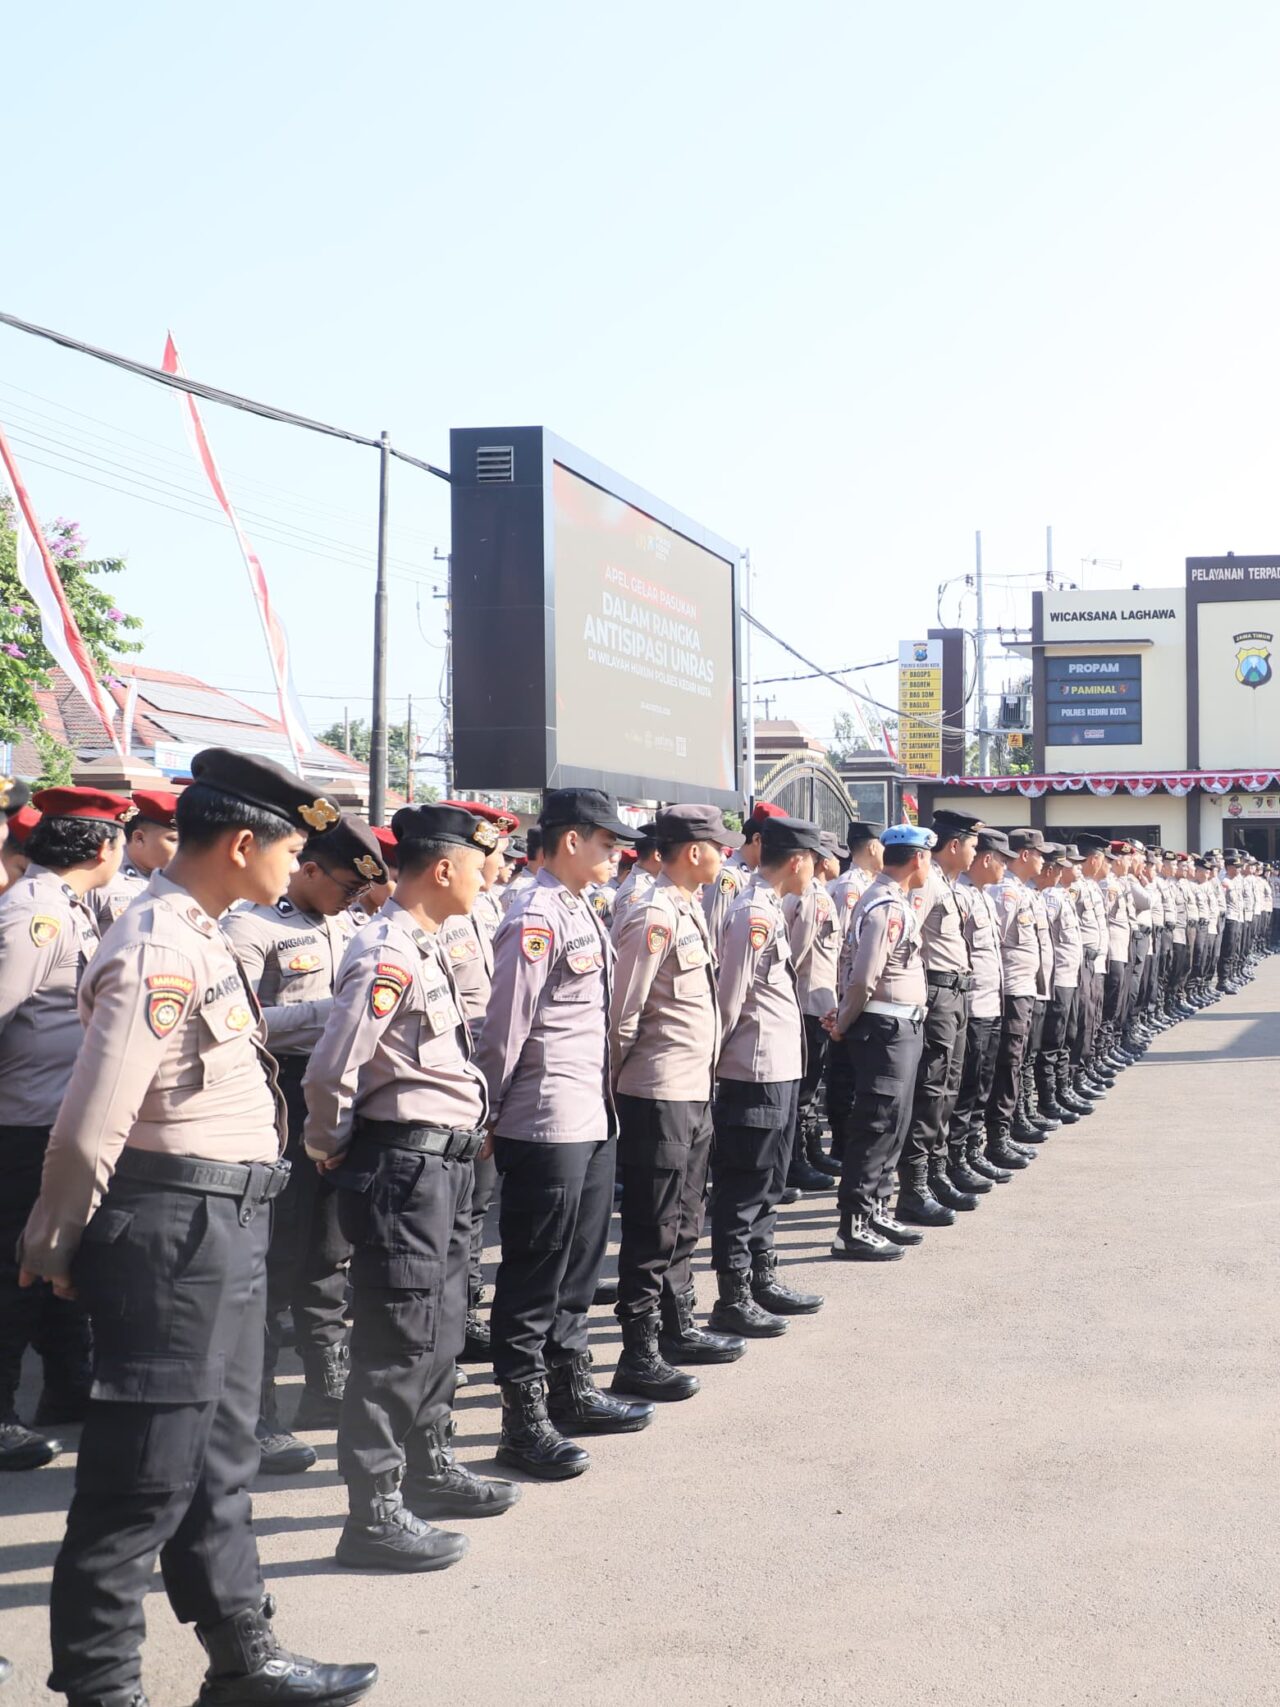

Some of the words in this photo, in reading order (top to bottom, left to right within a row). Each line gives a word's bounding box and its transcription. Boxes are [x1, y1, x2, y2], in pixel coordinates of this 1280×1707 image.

[1191, 567, 1244, 582] PELAYANAN
[605, 564, 629, 590] APEL
[631, 577, 659, 602] GELAR
[660, 590, 697, 620] PASUKAN
[602, 591, 650, 631] DALAM
[653, 614, 702, 652] RANGKA
[1050, 610, 1117, 622] WICAKSANA
[1121, 609, 1176, 621] LAGHAWA
[584, 613, 668, 668] ANTISIPASI
[671, 643, 715, 684] UNRAS
[588, 648, 598, 662] DI
[598, 651, 630, 673] WILAYAH
[1069, 663, 1119, 673] PROPAM
[1071, 685, 1117, 695] PAMINAL
[1061, 708, 1085, 717] POLRES
[1087, 707, 1109, 716] KEDIRI
[1110, 707, 1127, 716] KOTA
